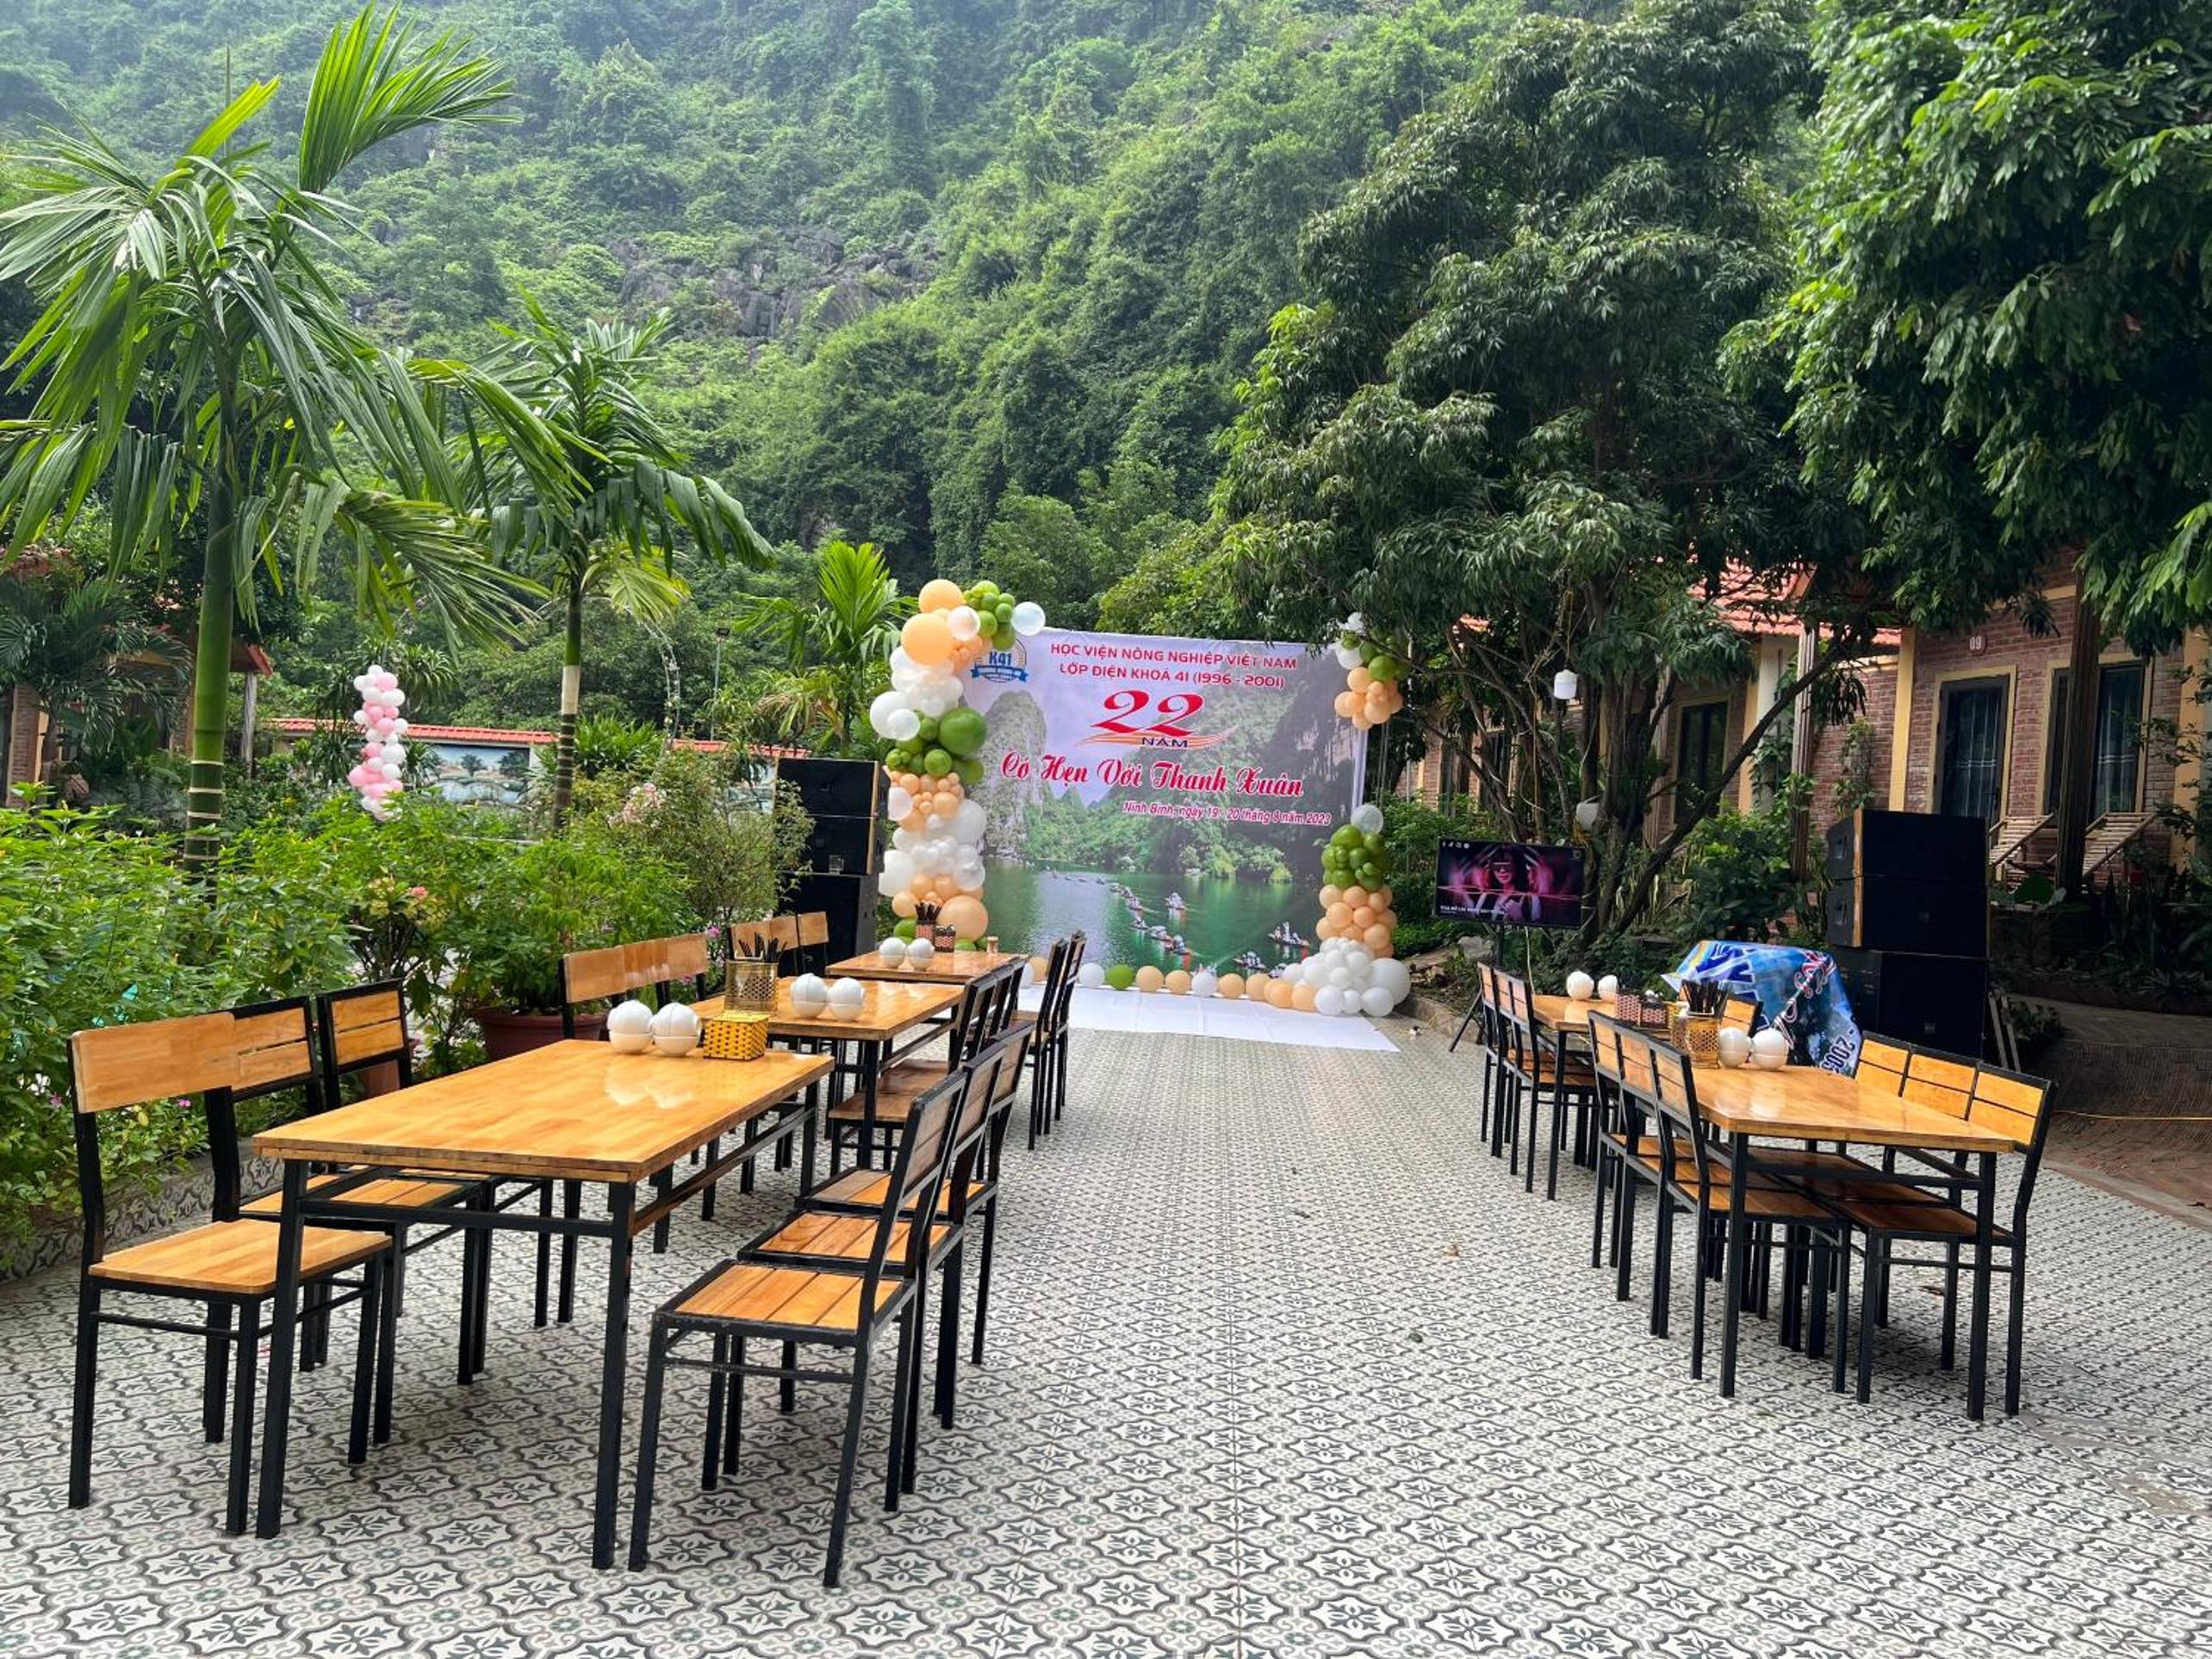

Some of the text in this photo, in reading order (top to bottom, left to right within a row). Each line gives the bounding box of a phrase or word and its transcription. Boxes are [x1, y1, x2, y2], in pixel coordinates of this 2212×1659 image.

[989, 651, 1012, 666] K41
[1051, 643, 1297, 669] HỌC VIỆN NÔNG NGHIỆP VIỆT NAM
[1059, 662, 1088, 674] LỚP
[1092, 664, 1127, 680] ĐIỆN
[1175, 671, 1189, 682] 41
[1193, 672, 1232, 686] (1996
[1244, 675, 1284, 689] 2001)
[1090, 690, 1203, 737] 22
[1002, 752, 1303, 797] Có Hẹn Với Thanh Xuân
[1122, 801, 1146, 814] Ninh
[1227, 808, 1239, 820] 20
[1240, 808, 1271, 824] tháng
[1307, 812, 1333, 826] 2023
